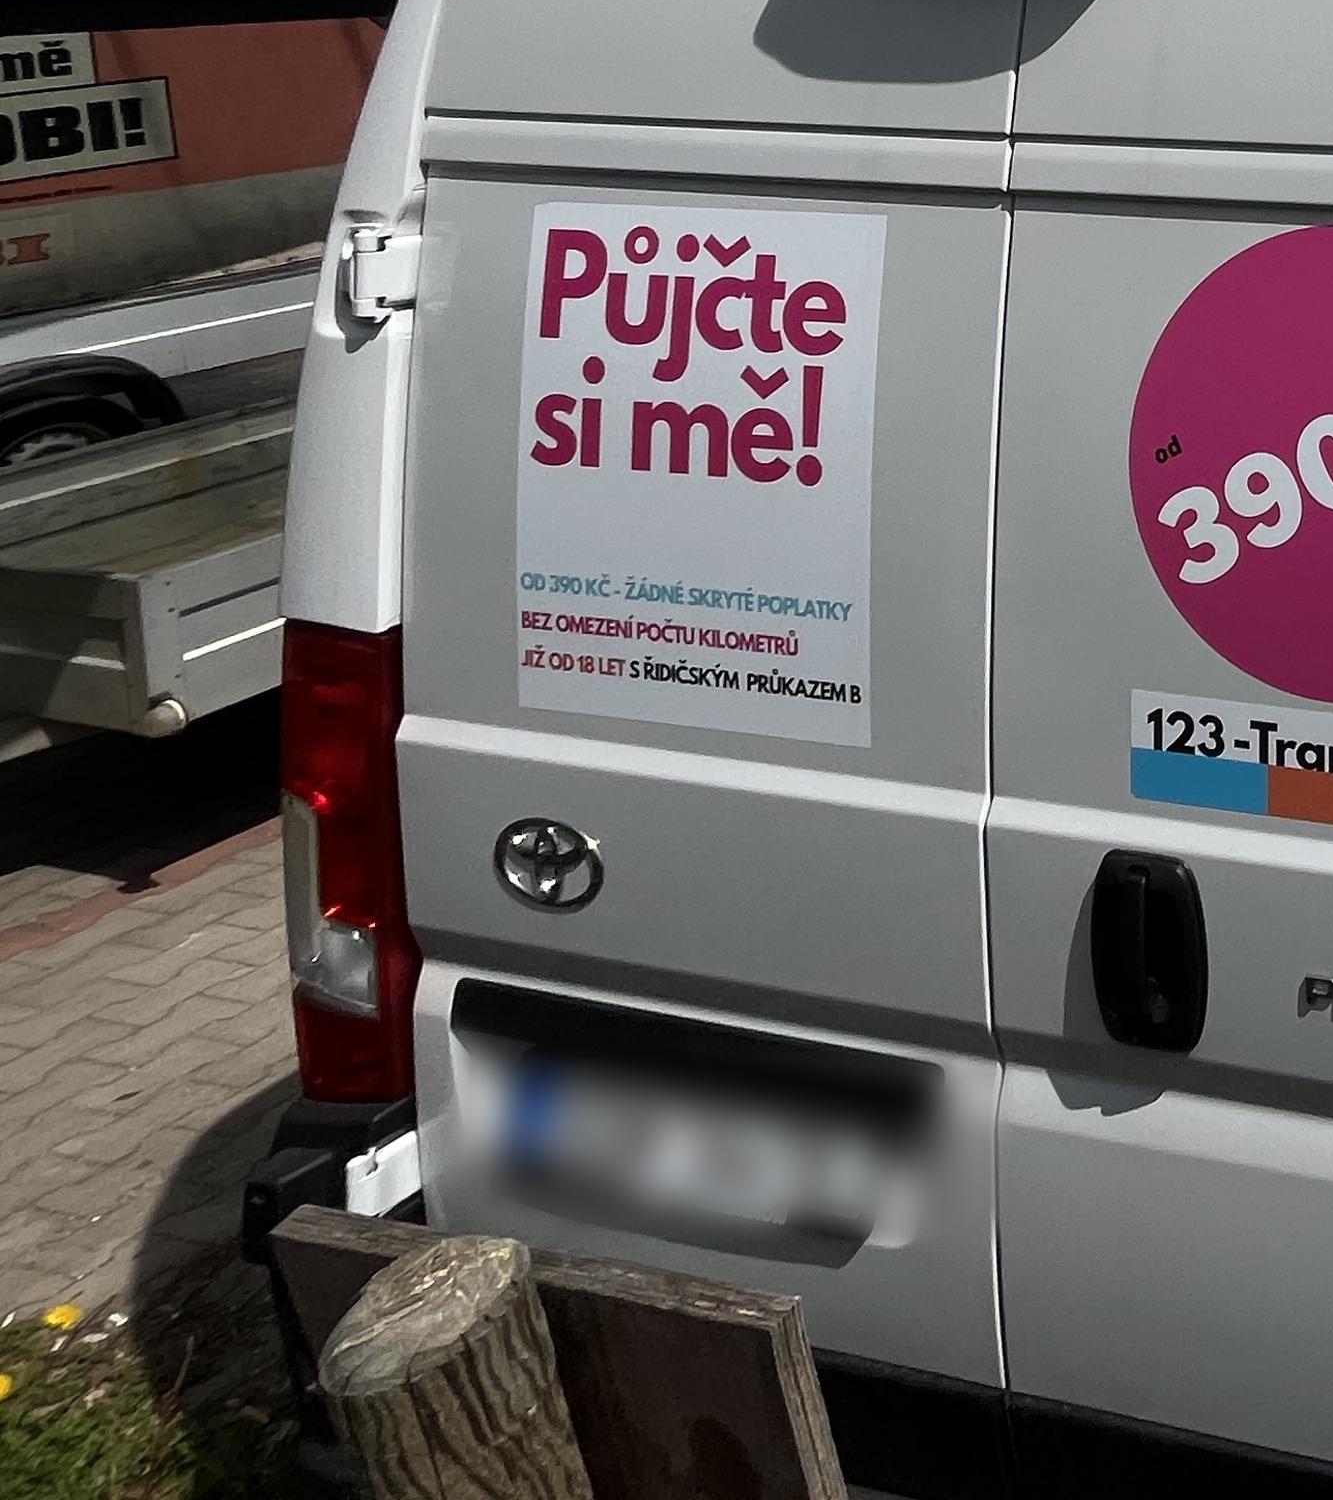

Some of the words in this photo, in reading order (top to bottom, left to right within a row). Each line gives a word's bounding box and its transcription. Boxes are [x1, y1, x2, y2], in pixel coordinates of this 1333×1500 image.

[0, 97, 146, 166] BI!
[539, 225, 847, 383] Půjčte
[530, 355, 606, 468] si
[631, 365, 824, 487] mě!
[1155, 434, 1182, 464] od
[520, 572, 546, 591] OD
[550, 574, 582, 595] 390
[585, 573, 611, 598] KČ
[624, 576, 684, 604] ŽÁDNÉ
[688, 587, 754, 612] SKRYTÉ
[757, 595, 852, 623] POPLATKY
[521, 611, 552, 631] BEZ
[556, 614, 632, 638] OMEZENÍ
[636, 618, 696, 645] POČTU
[699, 629, 799, 656] KILOMETRŮ
[521, 644, 545, 668] JIŽ
[549, 652, 574, 671] OD
[576, 655, 595, 674] 18
[600, 657, 626, 677] LET
[629, 660, 640, 679] S
[644, 655, 740, 691] ŘIDIČSKÝM
[746, 668, 847, 703] PRŮKAZEM
[850, 685, 862, 704] B
